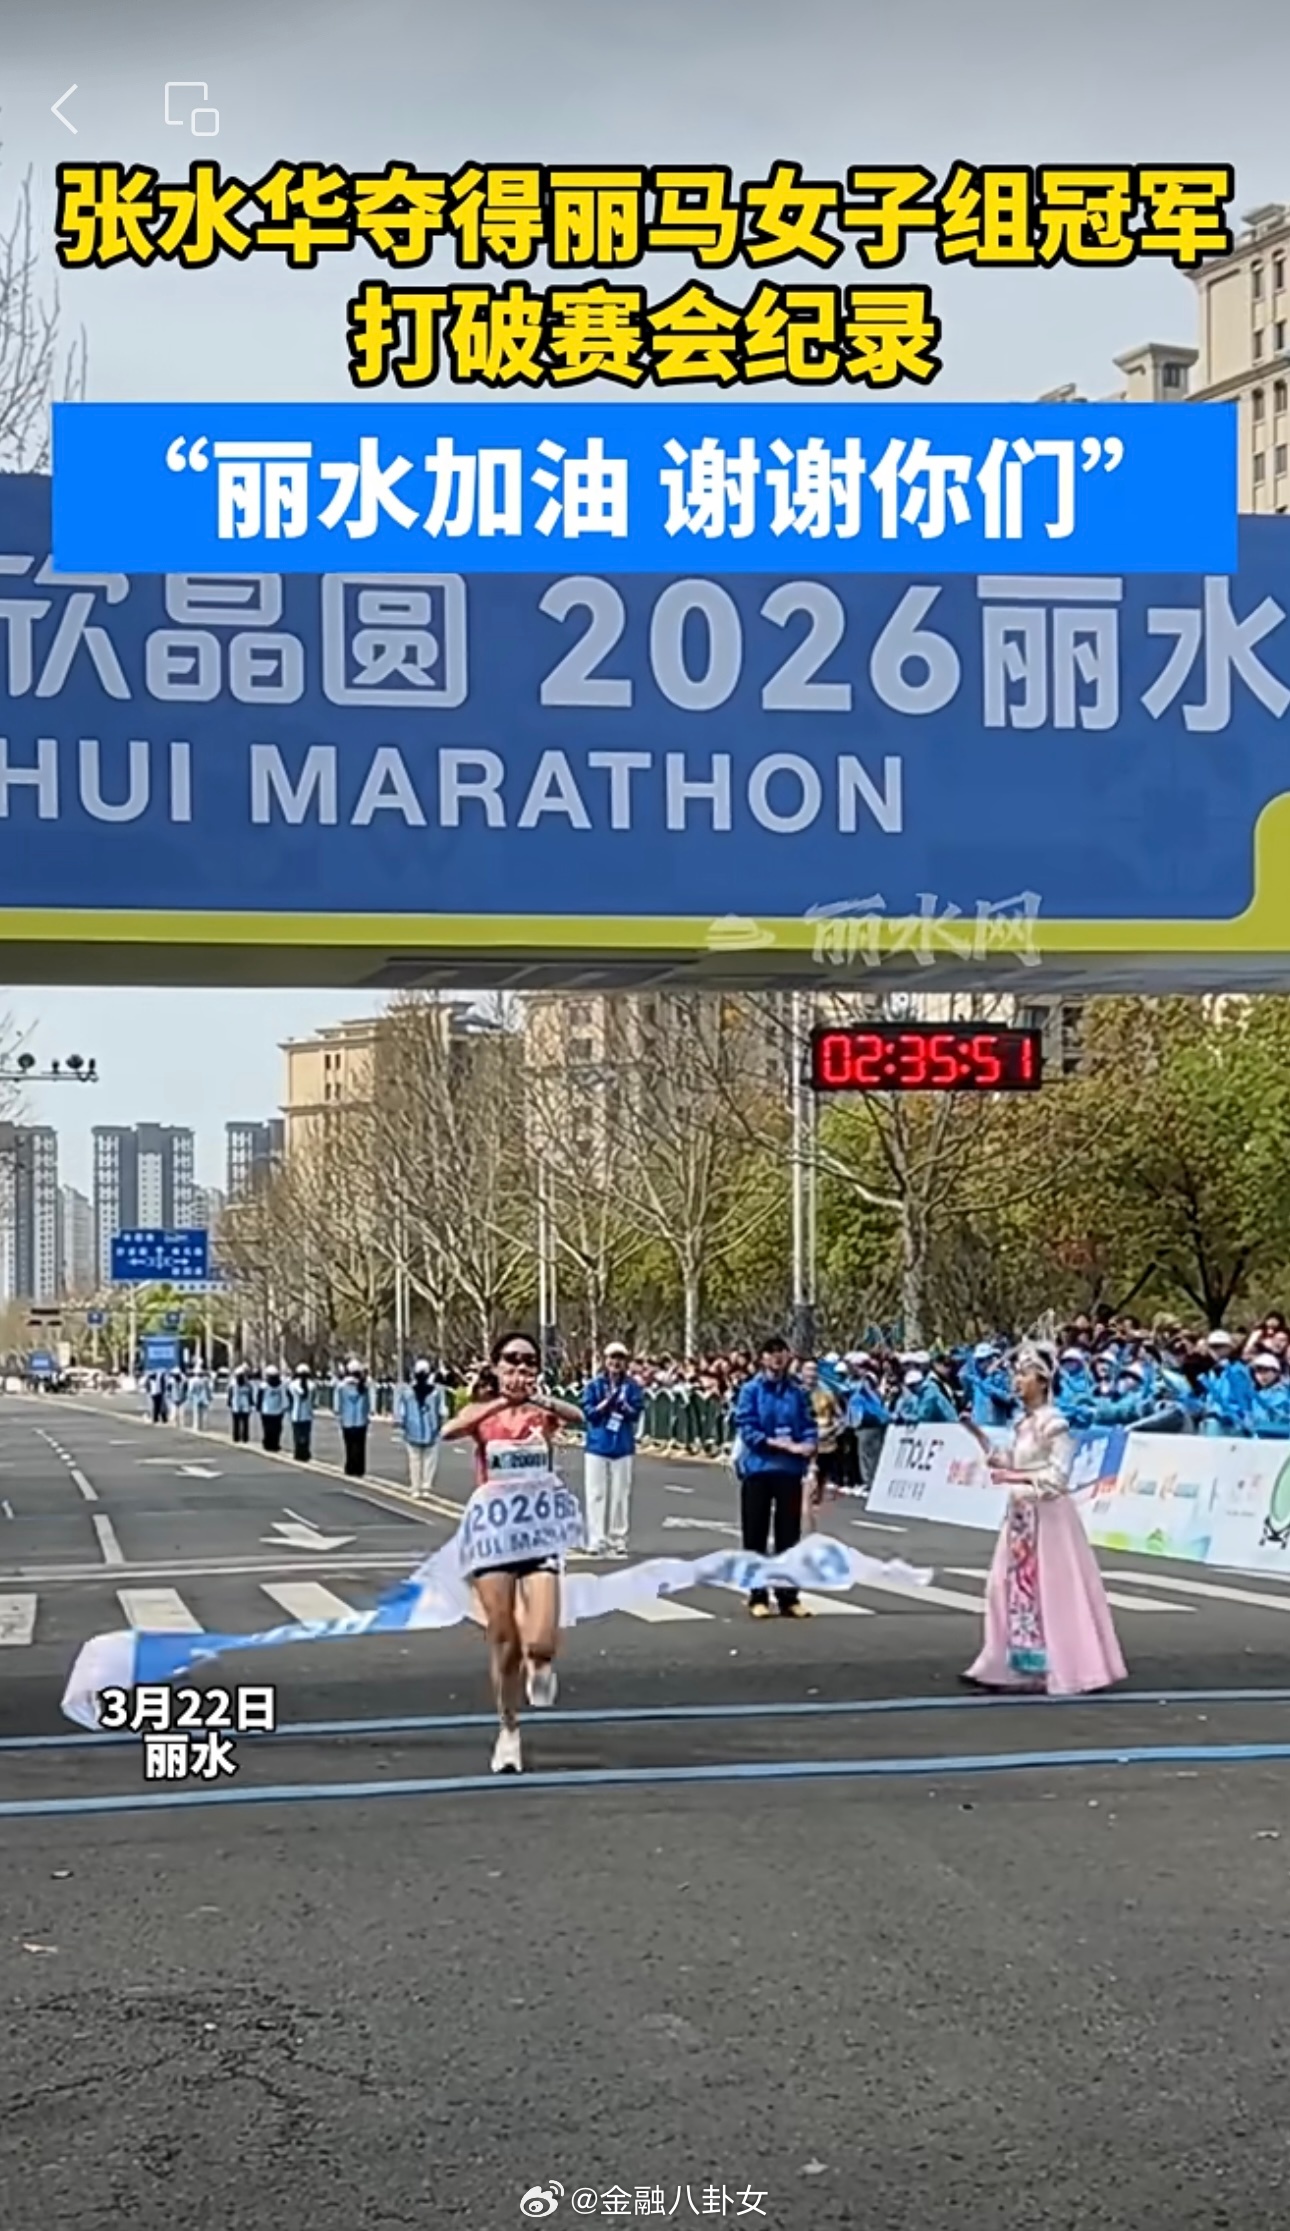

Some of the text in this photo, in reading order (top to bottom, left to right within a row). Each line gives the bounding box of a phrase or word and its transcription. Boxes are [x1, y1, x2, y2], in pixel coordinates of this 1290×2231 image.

[0, 738, 903, 833] HUI MARATHON
[822, 1035, 1033, 1083] 02:35:51
